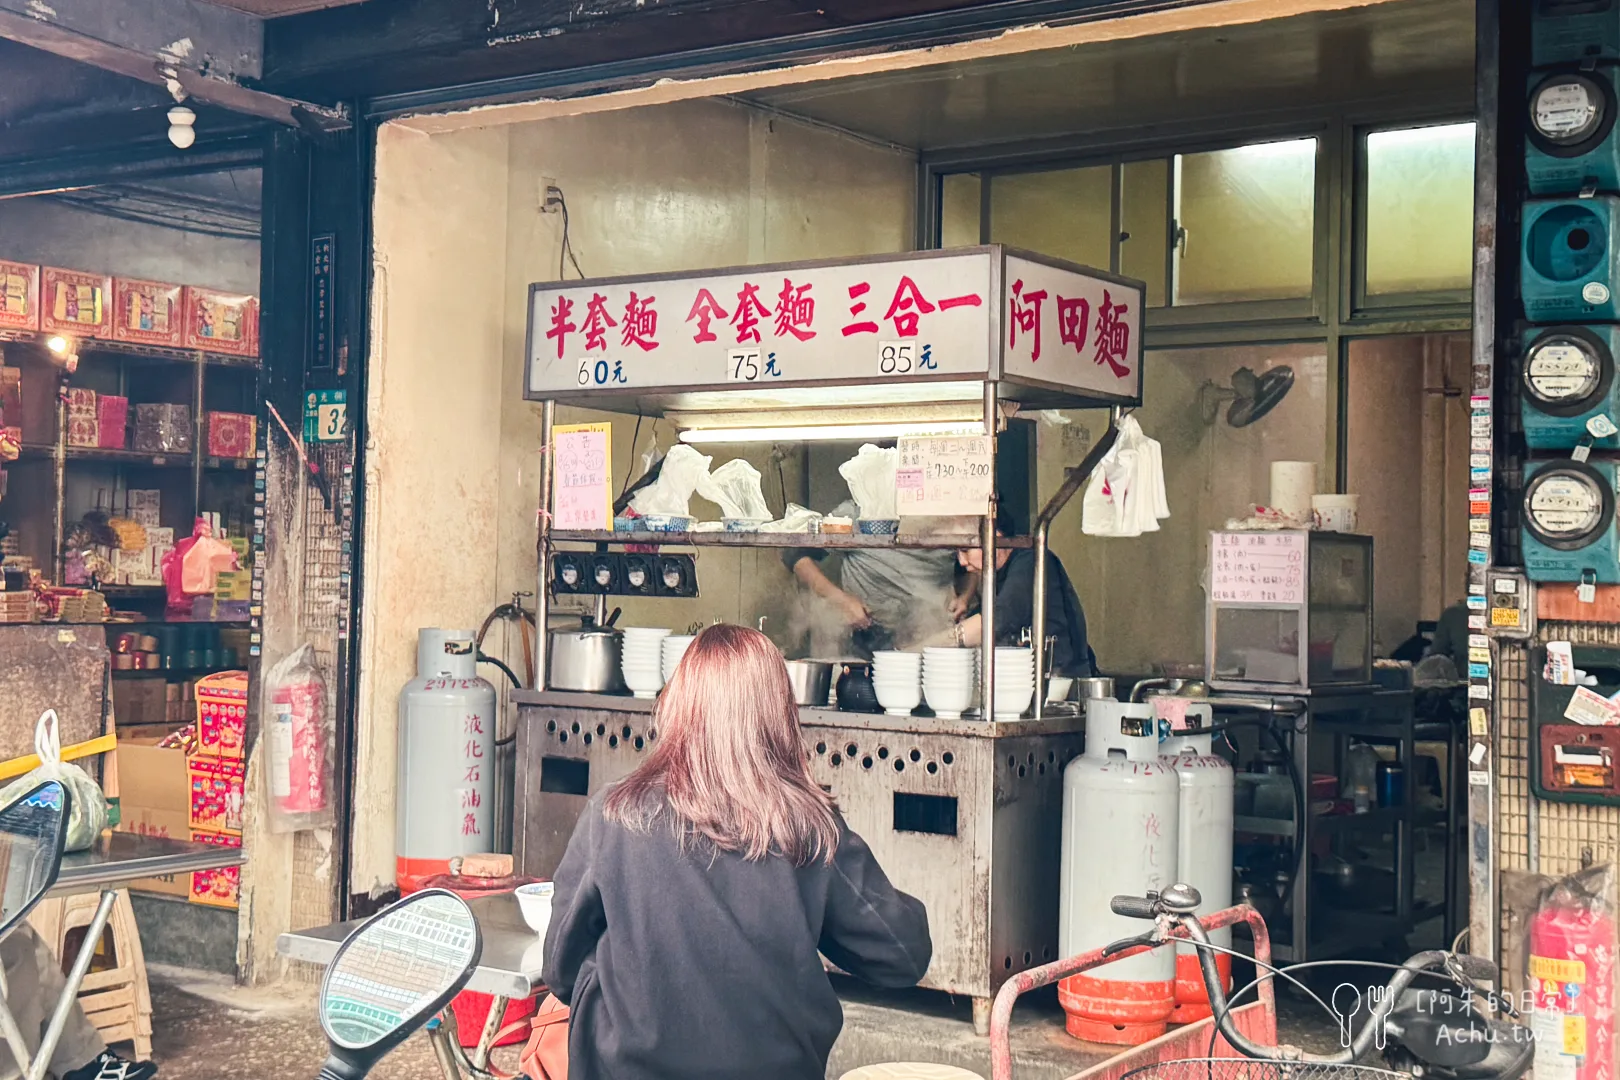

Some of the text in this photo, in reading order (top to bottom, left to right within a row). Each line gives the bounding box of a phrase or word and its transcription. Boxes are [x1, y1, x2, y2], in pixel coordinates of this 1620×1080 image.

[546, 275, 983, 360] 半套麵 全套麵 三合一
[1009, 279, 1131, 379] 阿田麵
[577, 360, 628, 385] 60元
[732, 352, 781, 380] 75元
[880, 343, 938, 374] 85元
[461, 714, 484, 836] 液化石油氣
